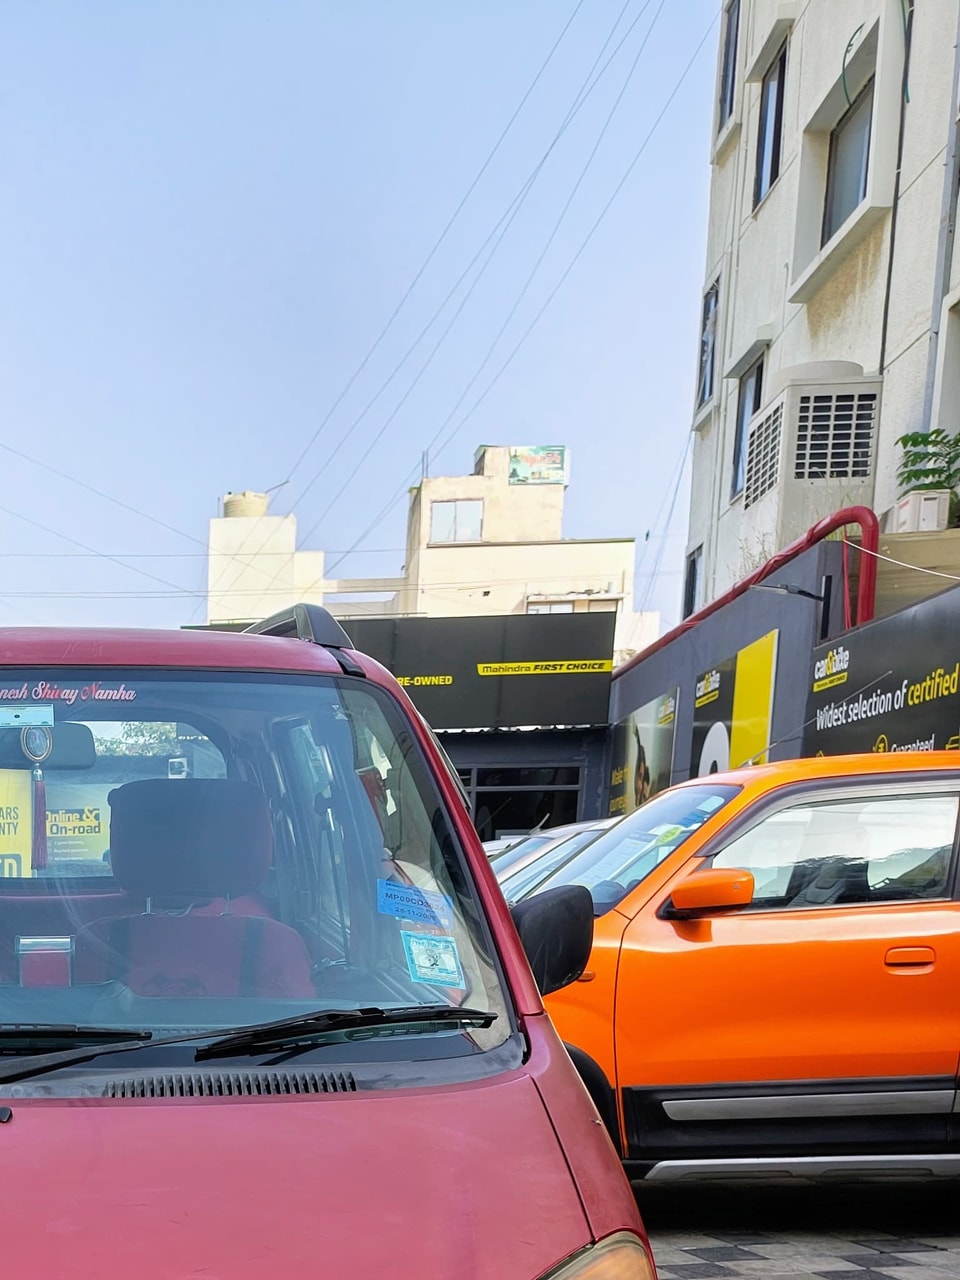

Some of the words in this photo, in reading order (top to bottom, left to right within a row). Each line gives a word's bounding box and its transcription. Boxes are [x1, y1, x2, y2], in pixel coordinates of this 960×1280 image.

[482, 664, 531, 673] Mahindra
[533, 663, 565, 672] FIRST
[566, 662, 606, 671] CHOICE
[814, 646, 850, 680] car&bike
[396, 675, 453, 686] RE-OWNED
[31, 681, 79, 705] Shivay
[80, 681, 137, 701] Namha
[815, 701, 847, 731] Widest
[847, 689, 892, 723] selection
[893, 679, 909, 710] of
[907, 662, 960, 706] certified
[82, 807, 101, 822] &
[50, 822, 101, 835] On-road
